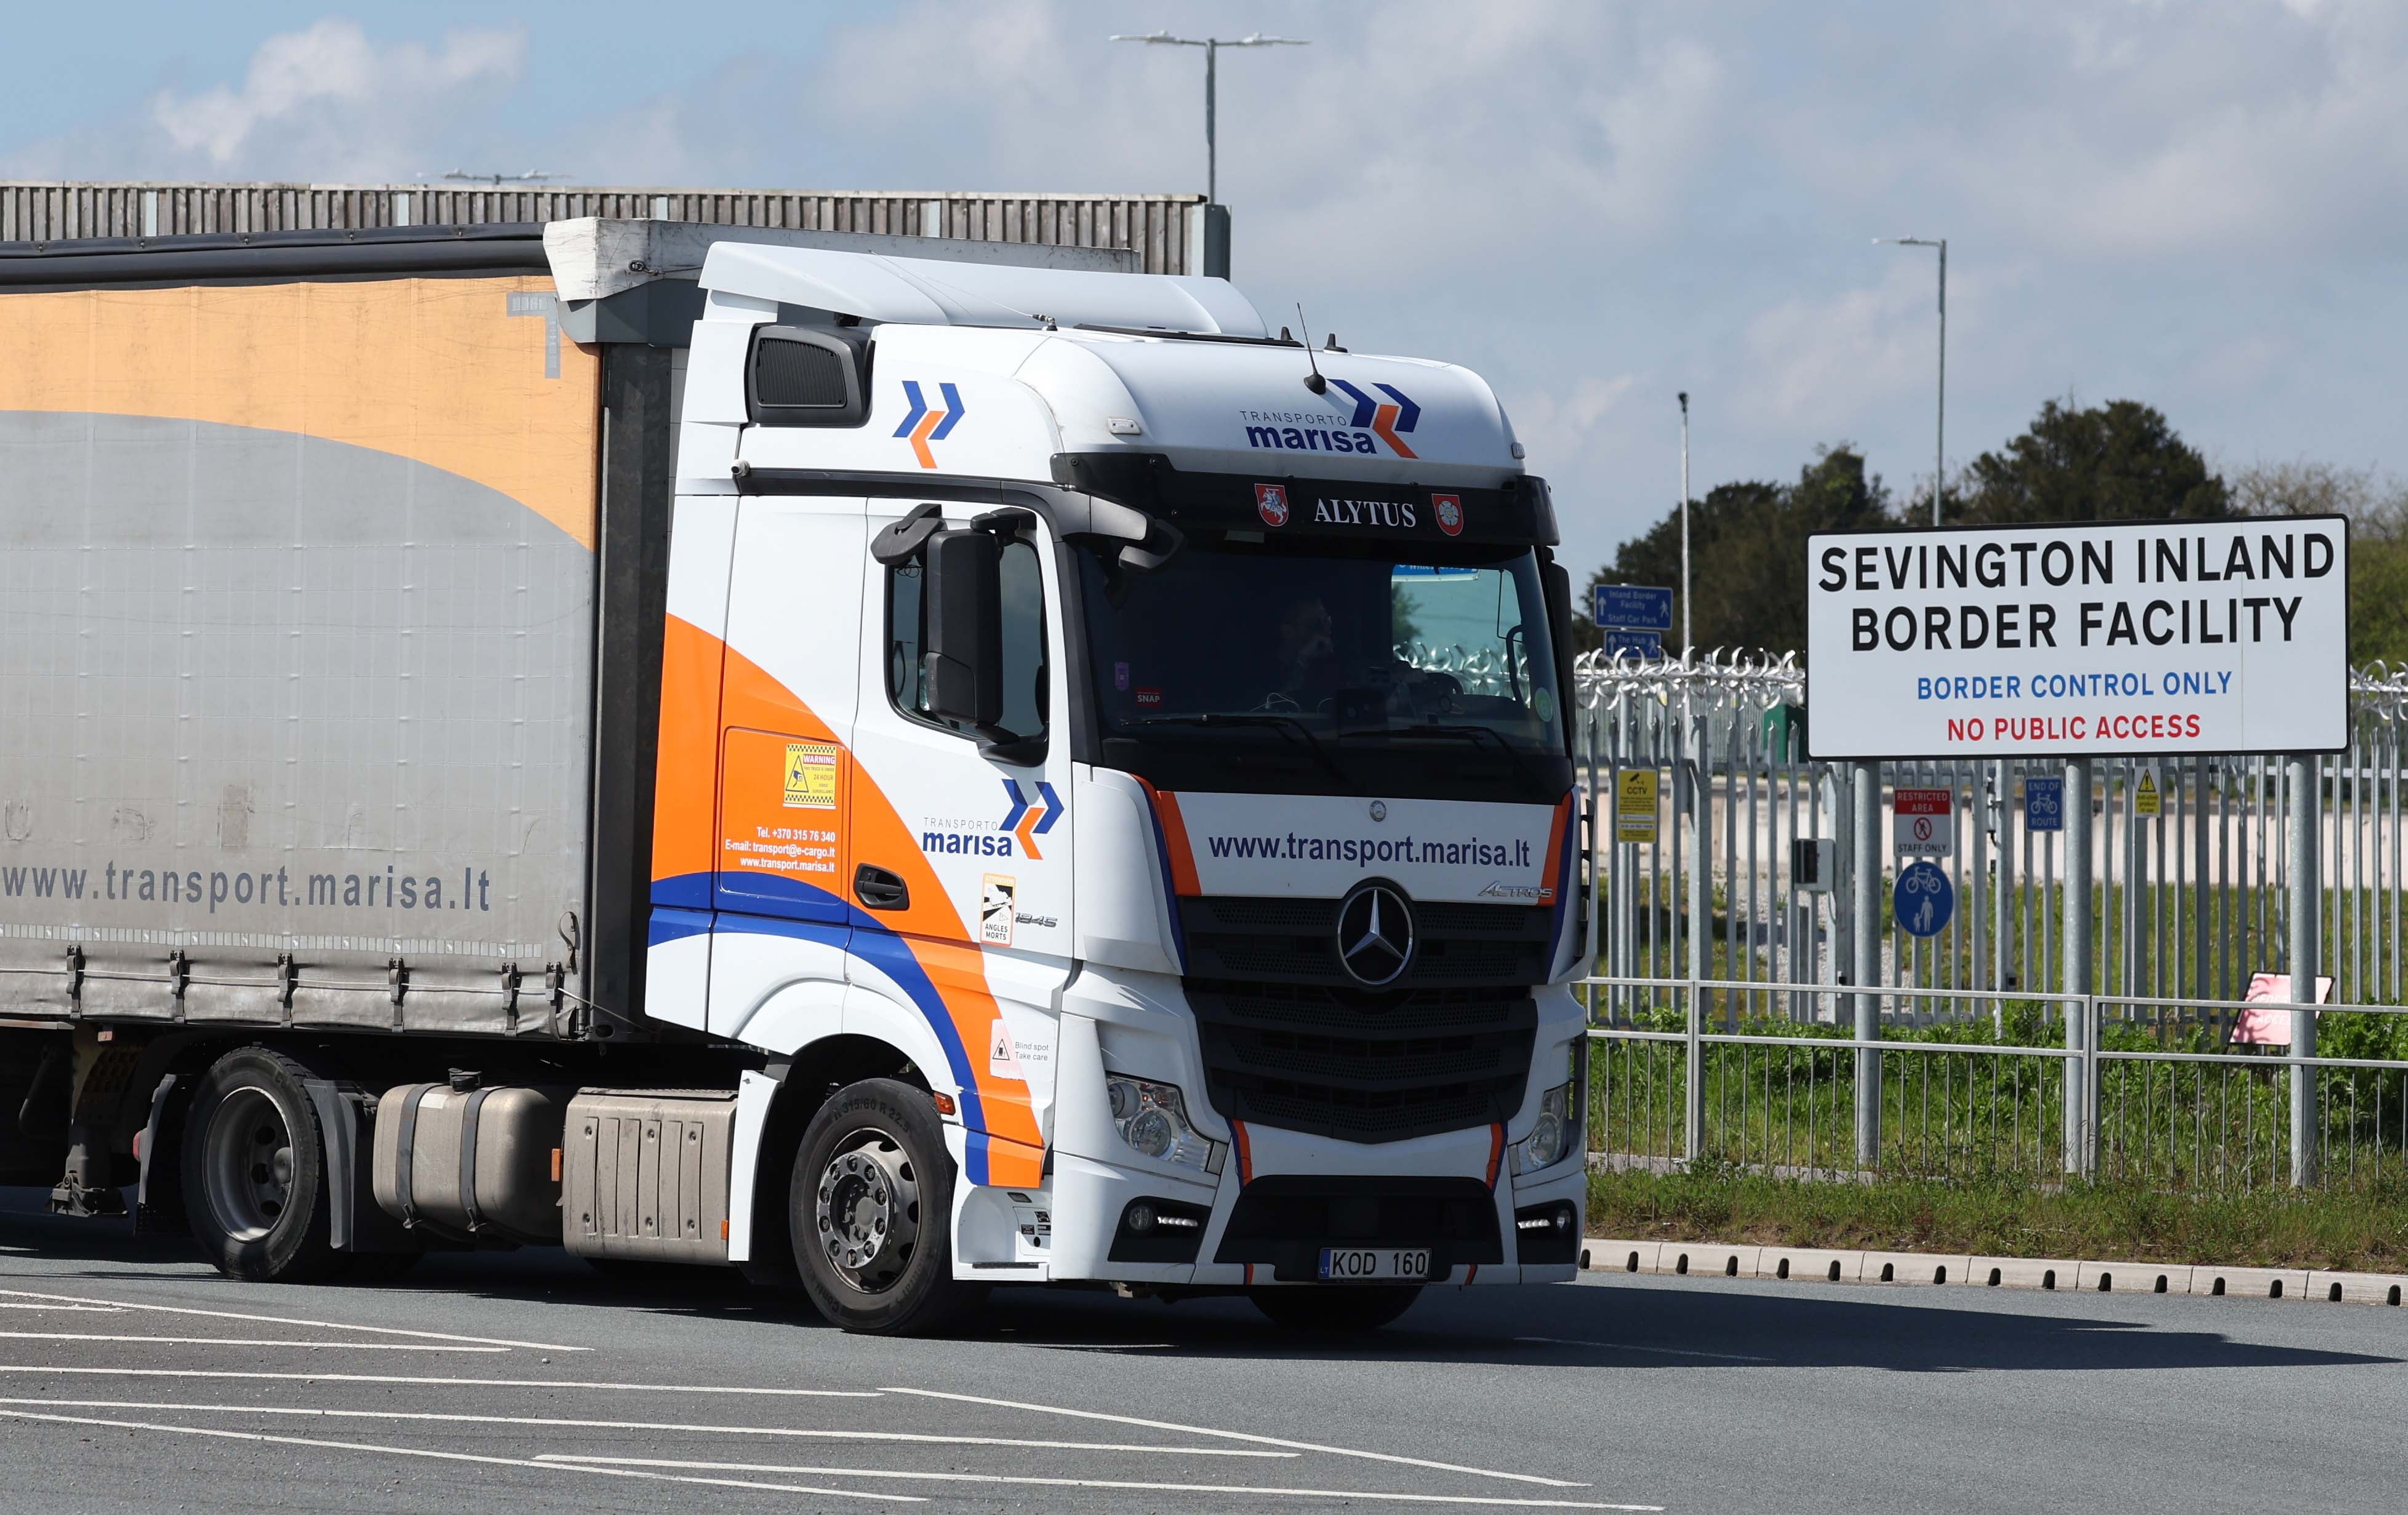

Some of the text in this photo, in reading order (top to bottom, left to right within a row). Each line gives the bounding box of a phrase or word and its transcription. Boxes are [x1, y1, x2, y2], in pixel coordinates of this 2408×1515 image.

[1240, 410, 1347, 426] TRANSPORTO
[1246, 426, 1377, 454] marisa
[1314, 498, 1417, 527] ALYTUS
[1818, 532, 2334, 593] SEVINGTON INLAND
[1633, 591, 1657, 600] Border
[1620, 601, 1646, 610] Facility
[1627, 615, 1640, 624] Car
[1642, 616, 1658, 625] Park
[1852, 596, 2302, 652] BORDER FACILITY
[1918, 671, 2232, 700] BORDER CONTROL ONLY
[1948, 714, 2201, 741] NO PUBLIC ACCESS
[804, 755, 834, 764] WARNING
[2029, 782, 2059, 791] END OF
[1897, 793, 1948, 801] RESTRICTED
[1912, 804, 1934, 812] AREA
[924, 817, 998, 831] TRANSPORTO
[2032, 818, 2058, 826] ROUTE
[756, 826, 836, 842] Tel. +370 315 76 340
[725, 839, 835, 859] E-mail: transport@e-cargo.lt
[923, 832, 1012, 857] marisa
[1209, 831, 1530, 868] www.transport.marisa.lt
[1898, 844, 1946, 853] STAFF ONLY
[740, 857, 834, 872] www.transport.marisa.lt
[2, 860, 490, 914] www.transport.marisa.lt
[1478, 881, 1554, 899] ACTROS
[985, 923, 1008, 933] ANGLES
[1015, 912, 1058, 928] 1845
[986, 932, 1007, 940] MORTS
[1015, 1041, 1032, 1050] Blind
[1332, 1252, 1426, 1275] KOD 160
